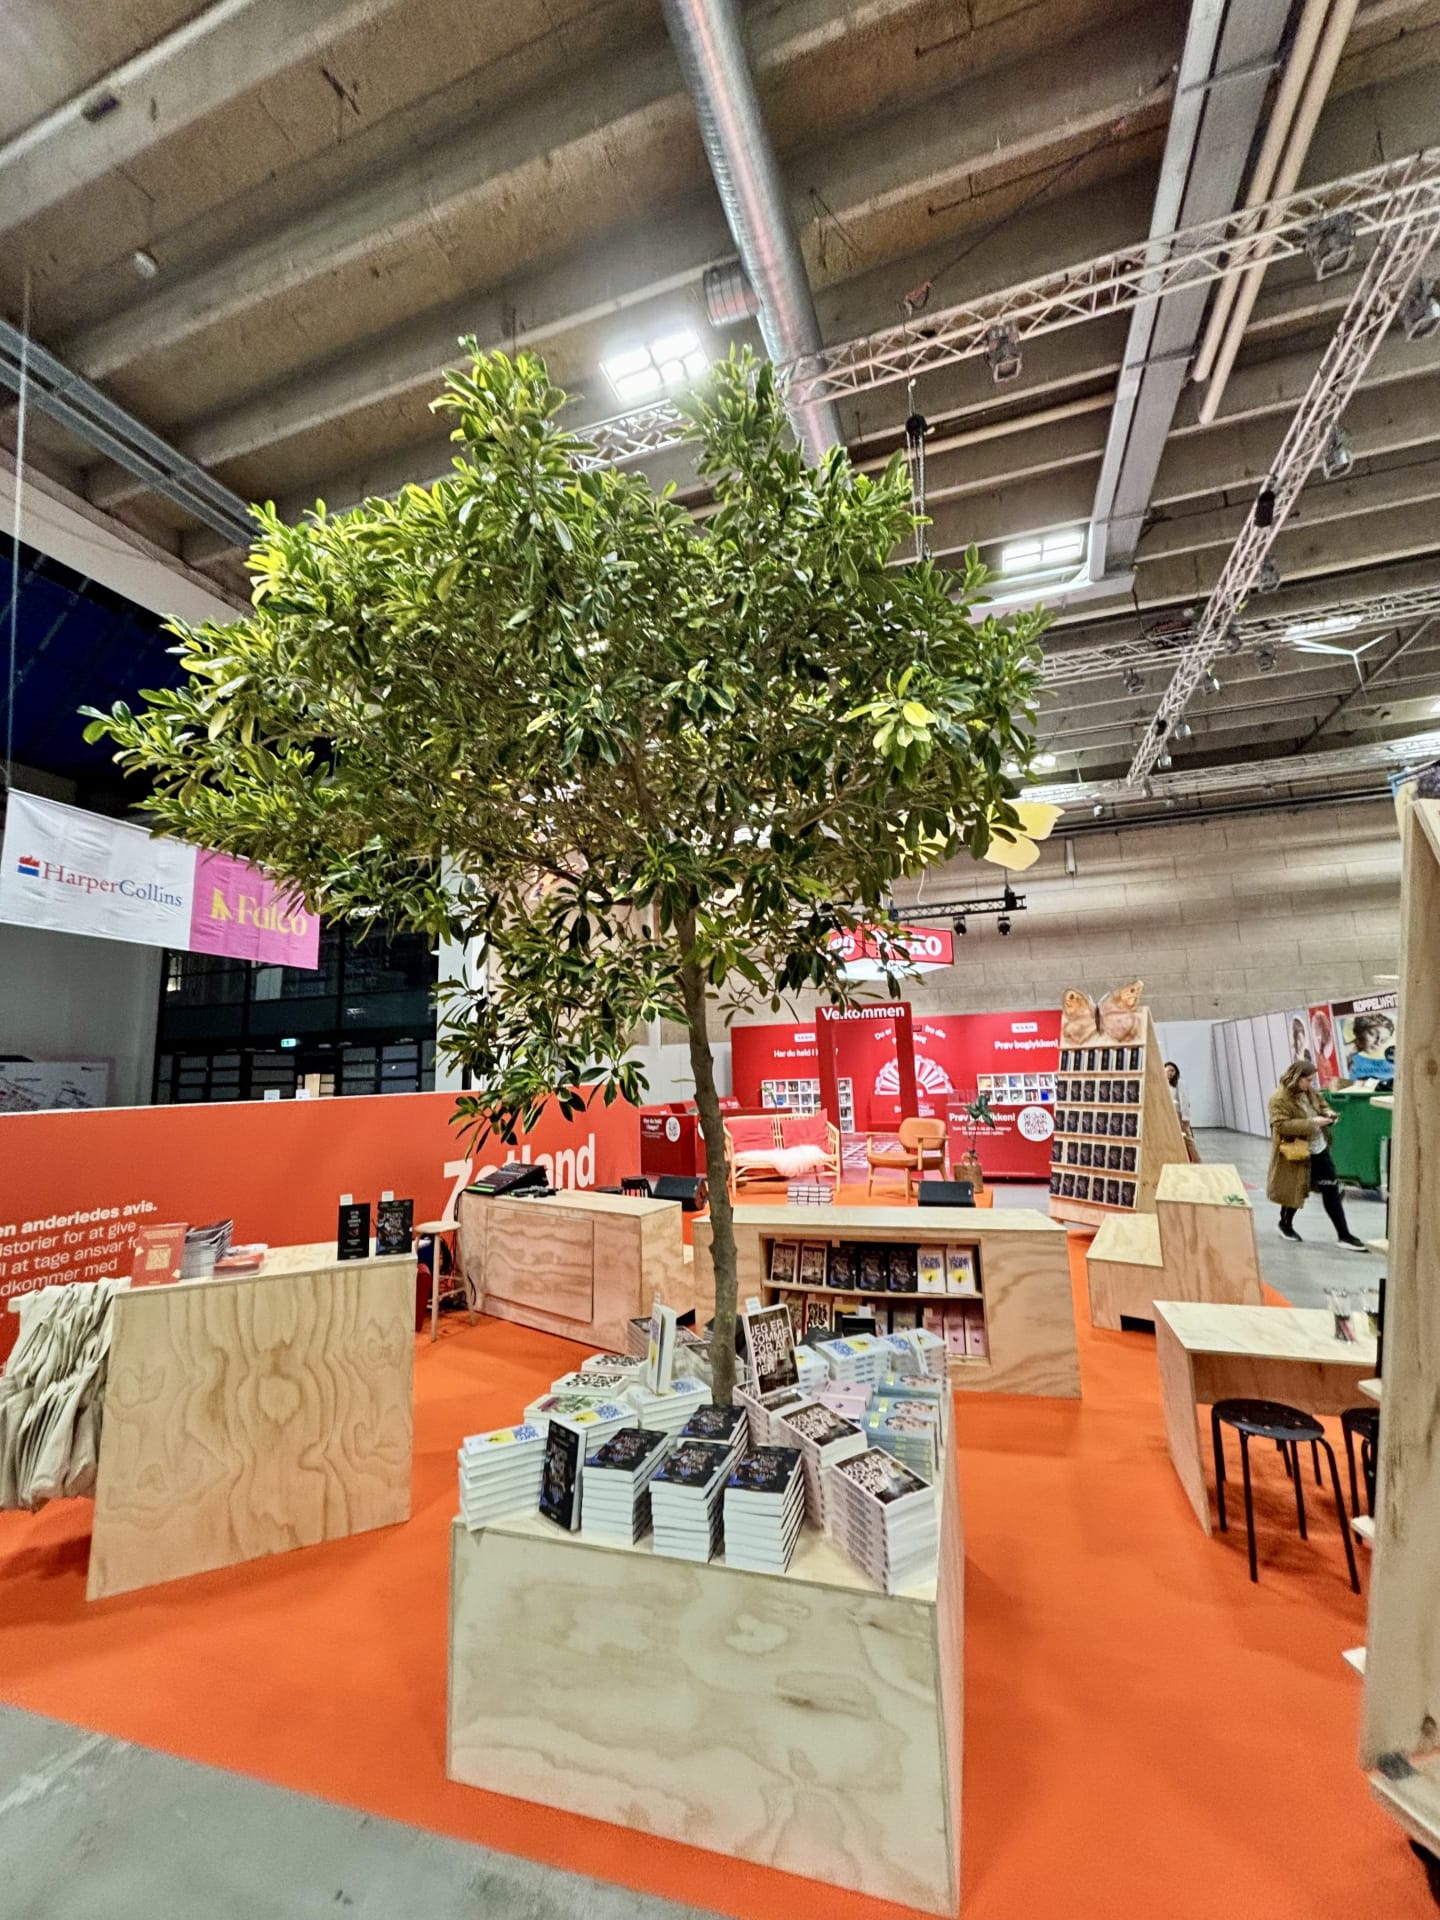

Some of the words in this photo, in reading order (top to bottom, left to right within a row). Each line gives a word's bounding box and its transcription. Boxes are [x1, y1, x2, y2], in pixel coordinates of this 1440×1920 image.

[41, 861, 183, 908] HarperCollins
[236, 894, 308, 937] Falco
[821, 1006, 905, 1021] Vekommen
[21, 1207, 120, 1234] anderledes
[122, 1200, 158, 1217] avis.
[63, 1230, 86, 1246] for
[89, 1226, 105, 1241] at
[108, 1221, 137, 1241] give
[11, 1259, 29, 1275] at
[34, 1251, 71, 1270] tage
[74, 1240, 125, 1262] ansvar
[84, 1257, 118, 1278] med
[750, 1322, 768, 1337] JEG
[769, 1318, 784, 1331] ER
